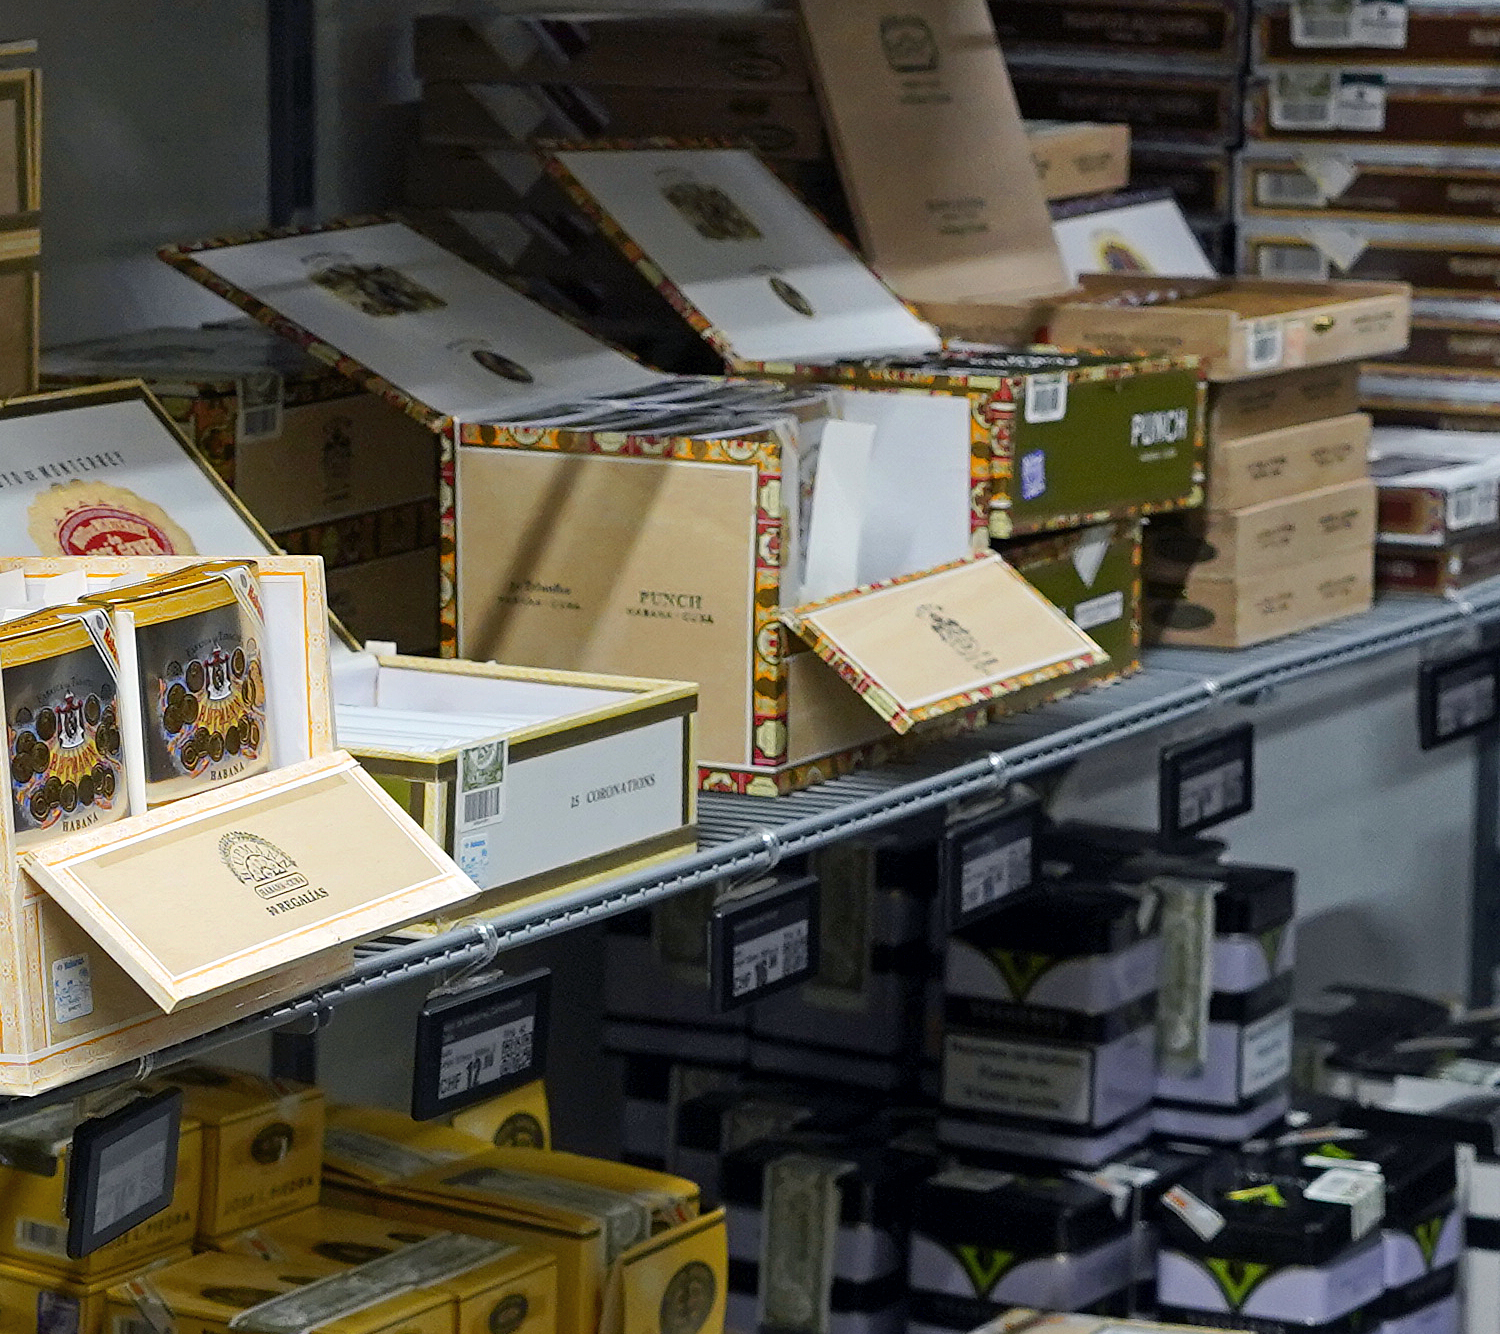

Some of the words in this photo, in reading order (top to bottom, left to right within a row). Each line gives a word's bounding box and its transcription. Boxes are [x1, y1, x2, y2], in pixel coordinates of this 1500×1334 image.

[1131, 408, 1189, 447] PUNCH
[638, 589, 704, 614] PUNCH
[276, 887, 329, 913] REGALÍAS
